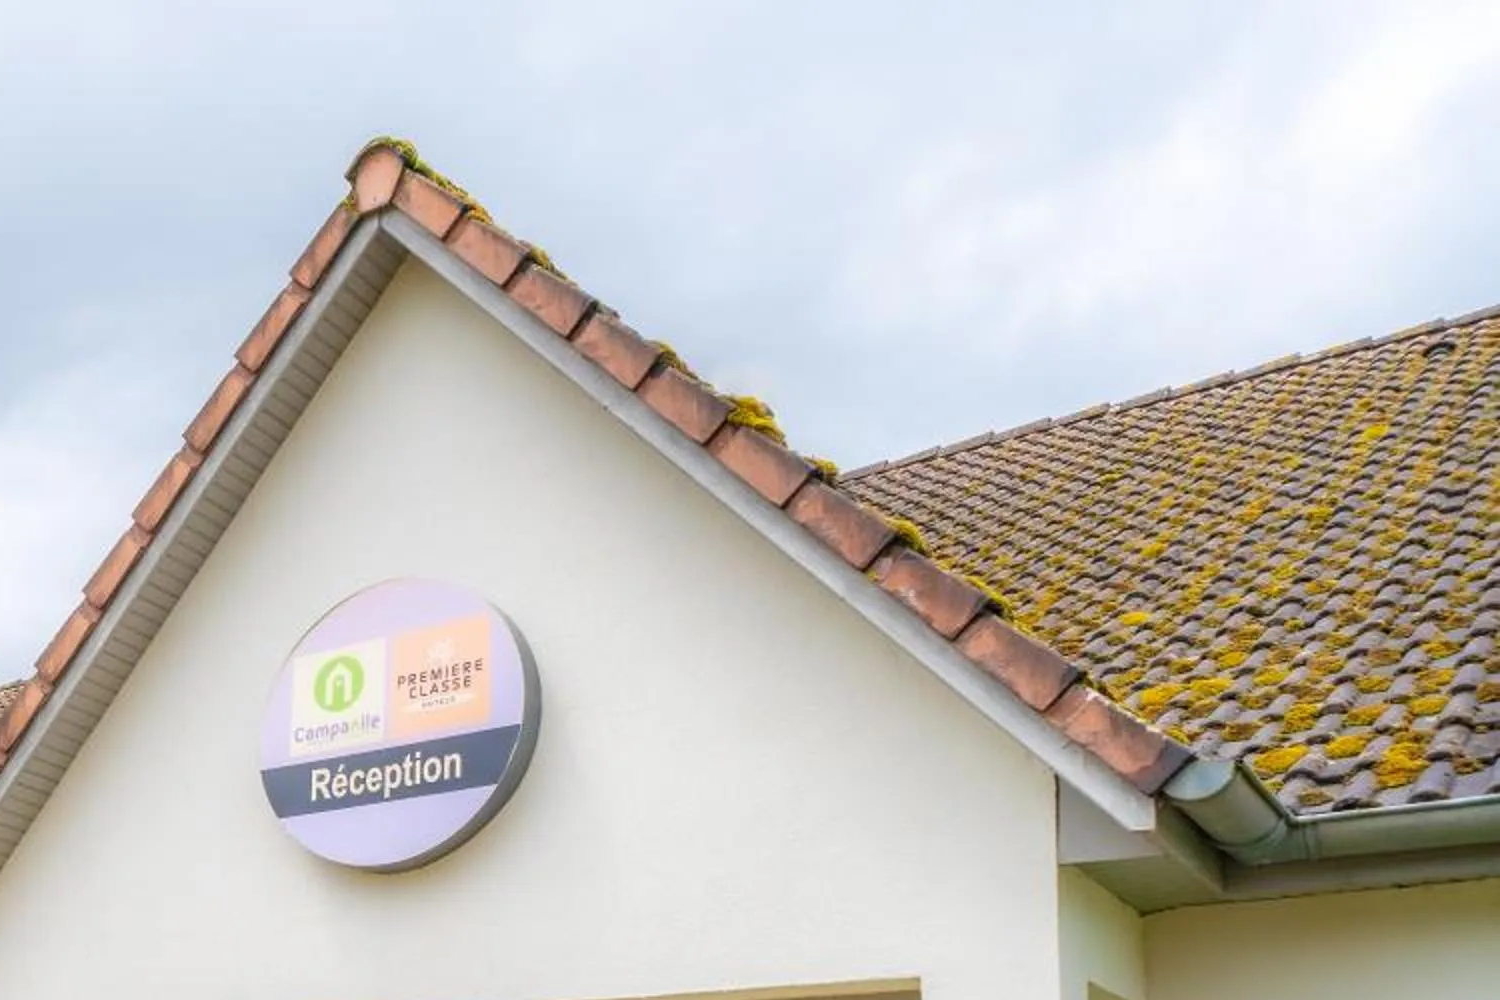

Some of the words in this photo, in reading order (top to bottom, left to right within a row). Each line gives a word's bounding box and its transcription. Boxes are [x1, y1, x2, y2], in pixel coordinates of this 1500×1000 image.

[409, 675, 472, 699] CLASSE
[294, 711, 381, 743] Campanile
[311, 751, 463, 802] Réception
